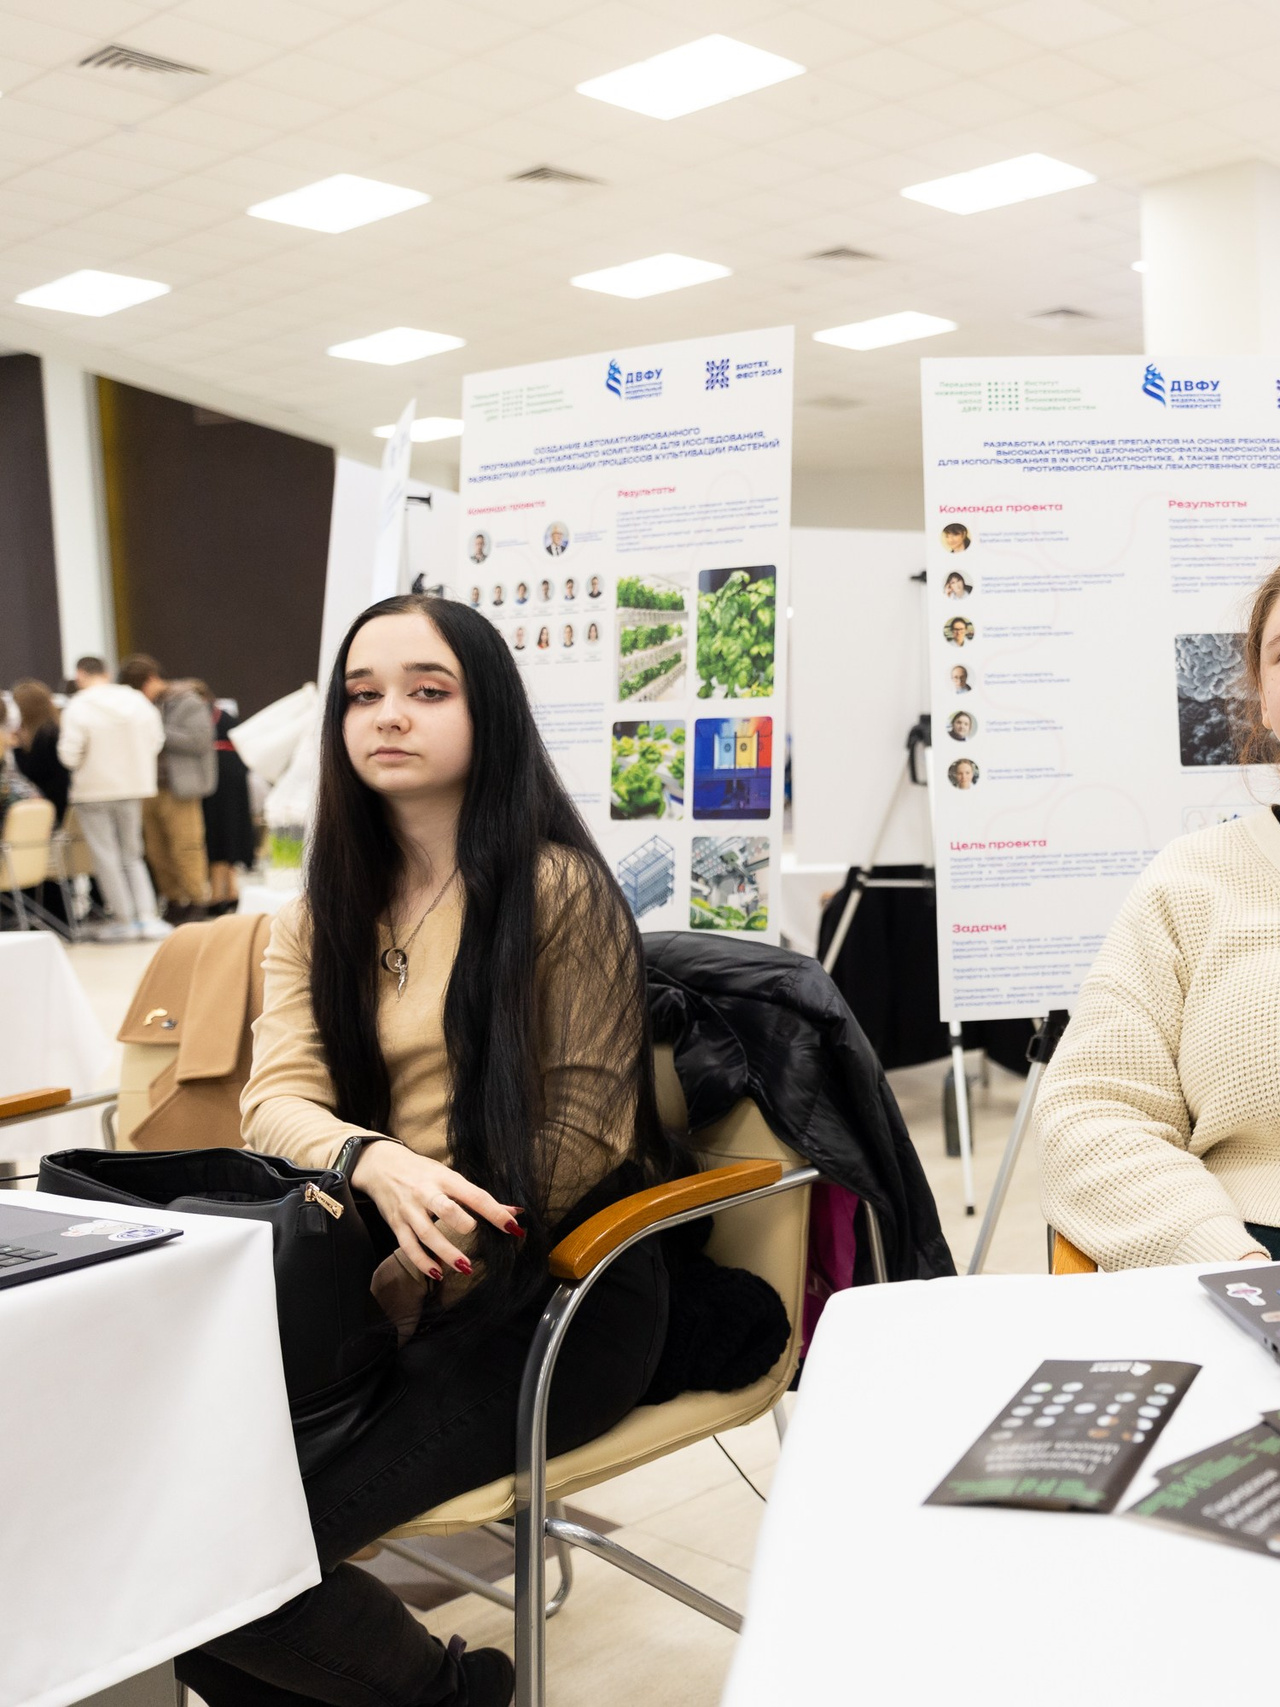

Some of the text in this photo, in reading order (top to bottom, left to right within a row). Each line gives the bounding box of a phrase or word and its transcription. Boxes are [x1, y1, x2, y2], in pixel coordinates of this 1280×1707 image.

[625, 368, 663, 385] ДВФУ
[1170, 380, 1220, 393] ДВФУ
[983, 440, 1046, 448] РАЗРАБОТКА
[1057, 439, 1116, 447] ПОЛУЧЕНИЕ
[1118, 438, 1180, 446] ПРЕПАРАТОВ
[1095, 445, 1152, 455] ЩЕЛОЧНОЙ
[1219, 445, 1267, 453] МОРСКОЙ
[961, 457, 1049, 466] ИСПОЛЬЗОВАНИЯ
[1022, 463, 1163, 472] ПРОТИВОВОСПАЛИТЕЛЬНЫХ
[939, 502, 1063, 514] Команда проекта
[1168, 500, 1247, 510] Результаты
[950, 838, 1047, 852] Цель проекта
[952, 923, 1007, 934] Задачи
